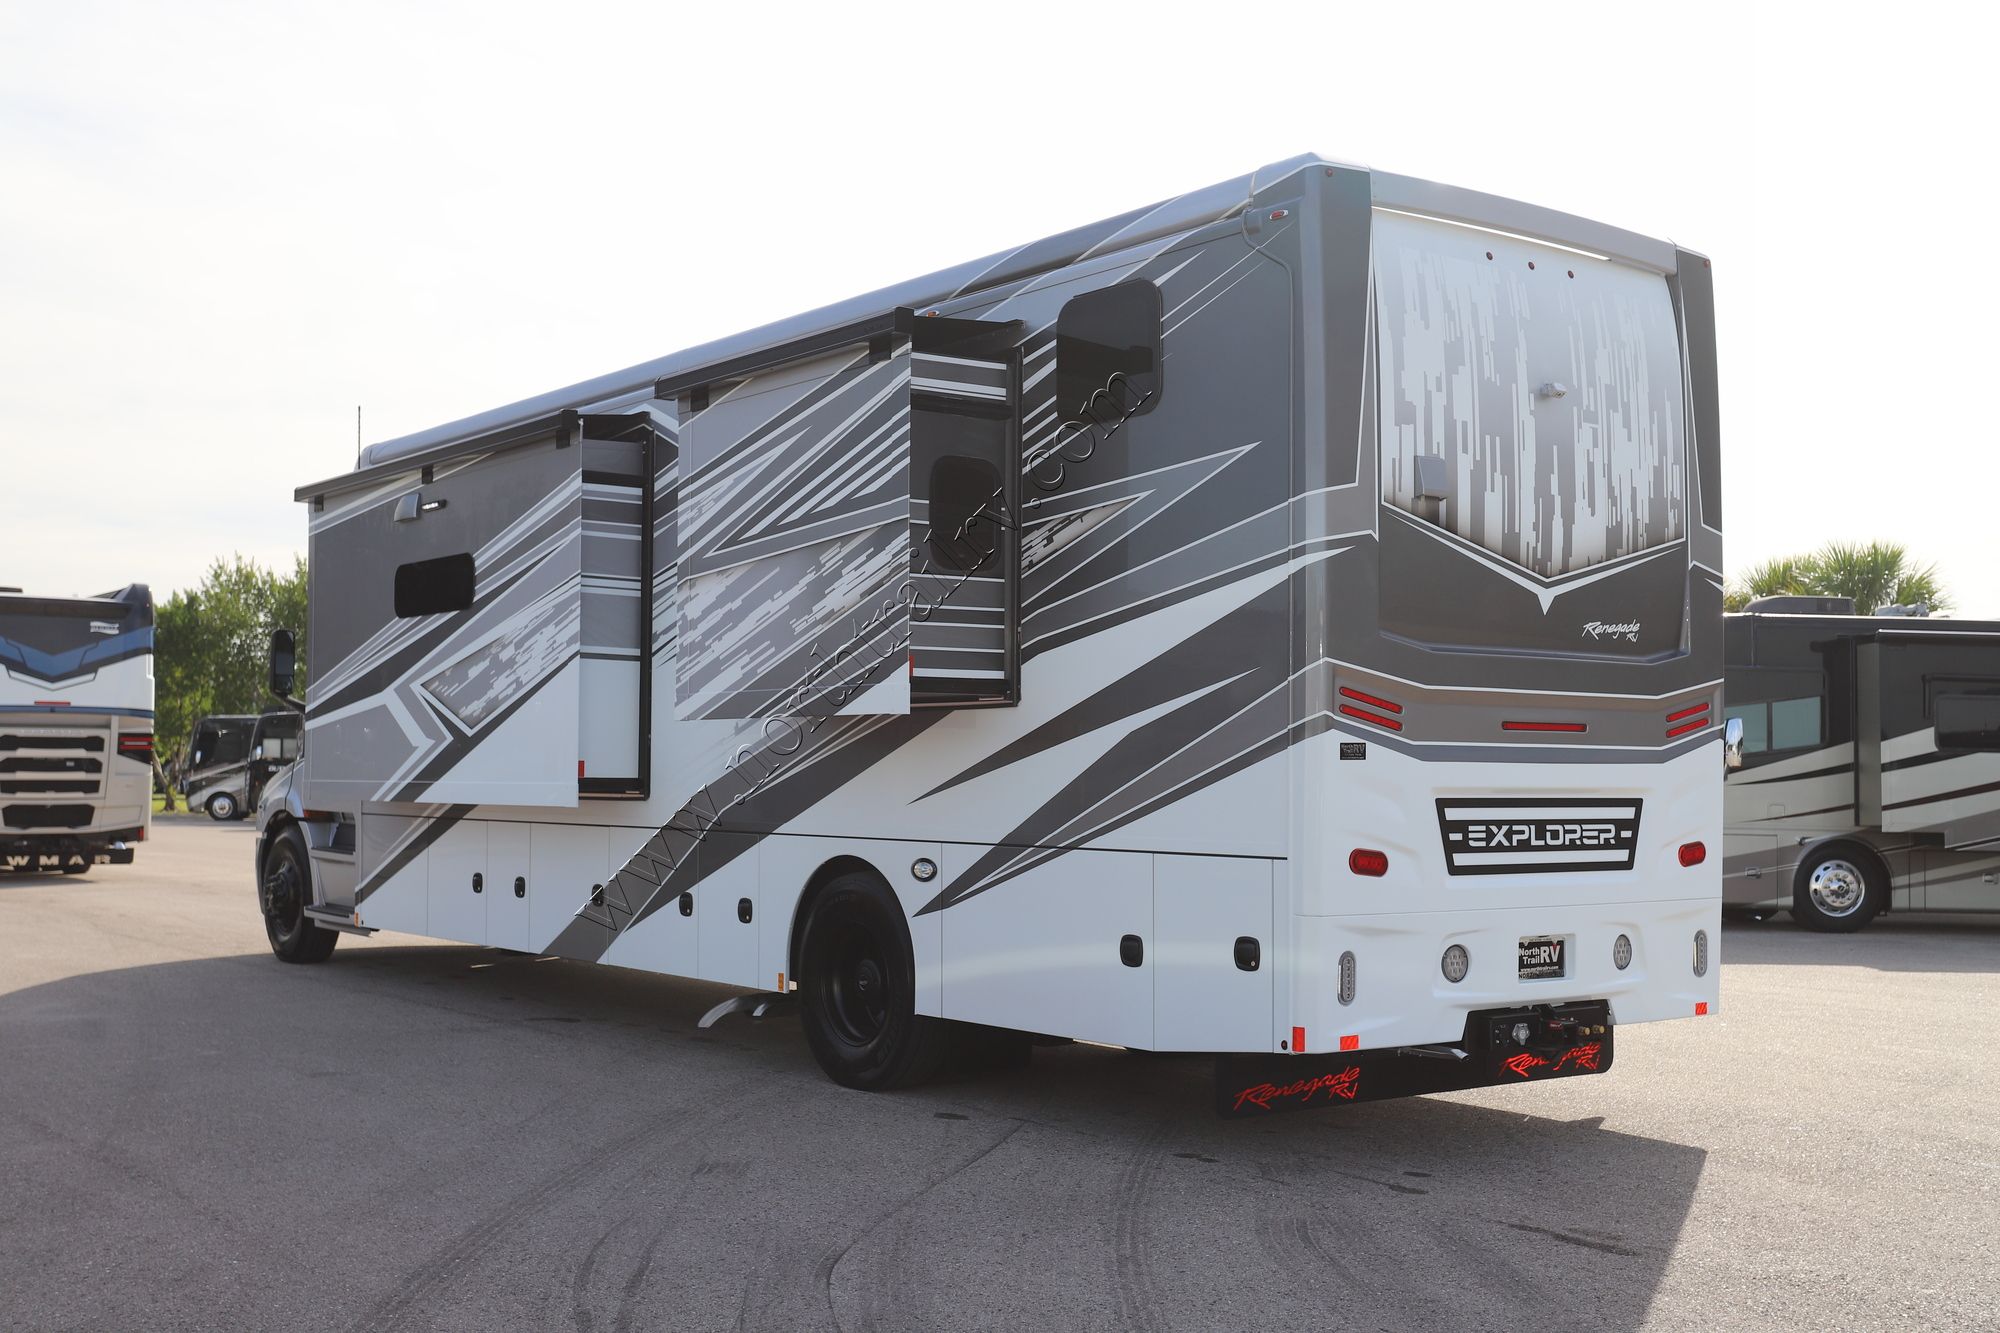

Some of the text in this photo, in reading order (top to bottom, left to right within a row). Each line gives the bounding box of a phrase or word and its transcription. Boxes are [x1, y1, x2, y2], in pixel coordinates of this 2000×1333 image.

[1582, 619, 1640, 640] Renegade
[1625, 632, 1639, 642] RV
[1468, 823, 1616, 847] EXPLORER
[1519, 947, 1540, 956] North
[1540, 944, 1561, 964] RV
[1522, 956, 1540, 965] Trail
[1575, 1054, 1601, 1070] RV
[1233, 1065, 1360, 1111] Renegade
[1328, 1082, 1359, 1099] RV
